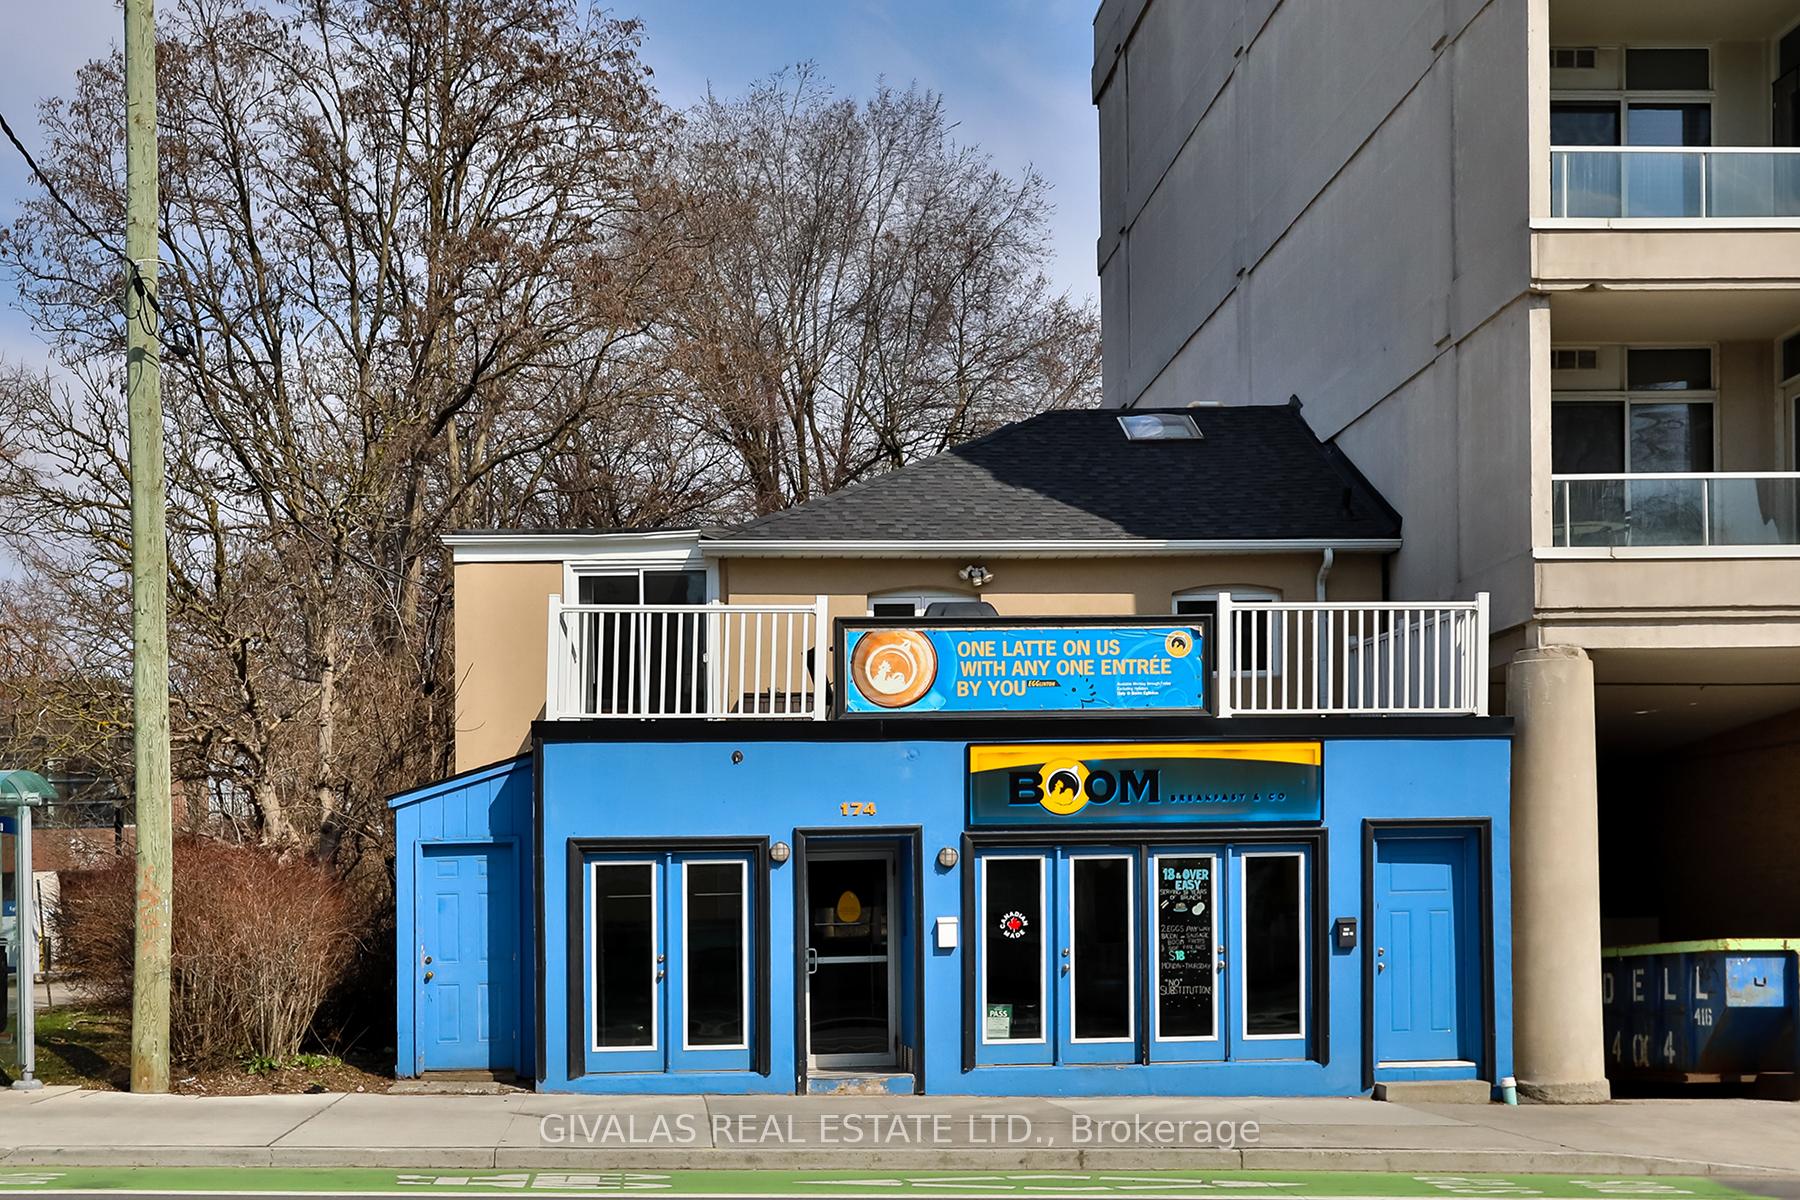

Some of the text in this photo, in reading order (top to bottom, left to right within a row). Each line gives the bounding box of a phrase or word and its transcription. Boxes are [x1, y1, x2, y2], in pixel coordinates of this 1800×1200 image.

[957, 639, 1120, 657] ONE LATTE ON US
[960, 654, 1172, 677] WITH ANY ONE ENTRÉE
[956, 681, 981, 697] BY
[987, 680, 1026, 697] YOU
[1169, 793, 1287, 804] BREAKFAST & CO
[840, 802, 876, 816] 174
[1162, 868, 1175, 880] 18
[1182, 868, 1209, 880] OVER
[1175, 879, 1201, 890] EASY
[999, 910, 1029, 930] CANADIAN
[1003, 930, 1026, 939] MADE
[989, 1010, 1008, 1018] PASS
